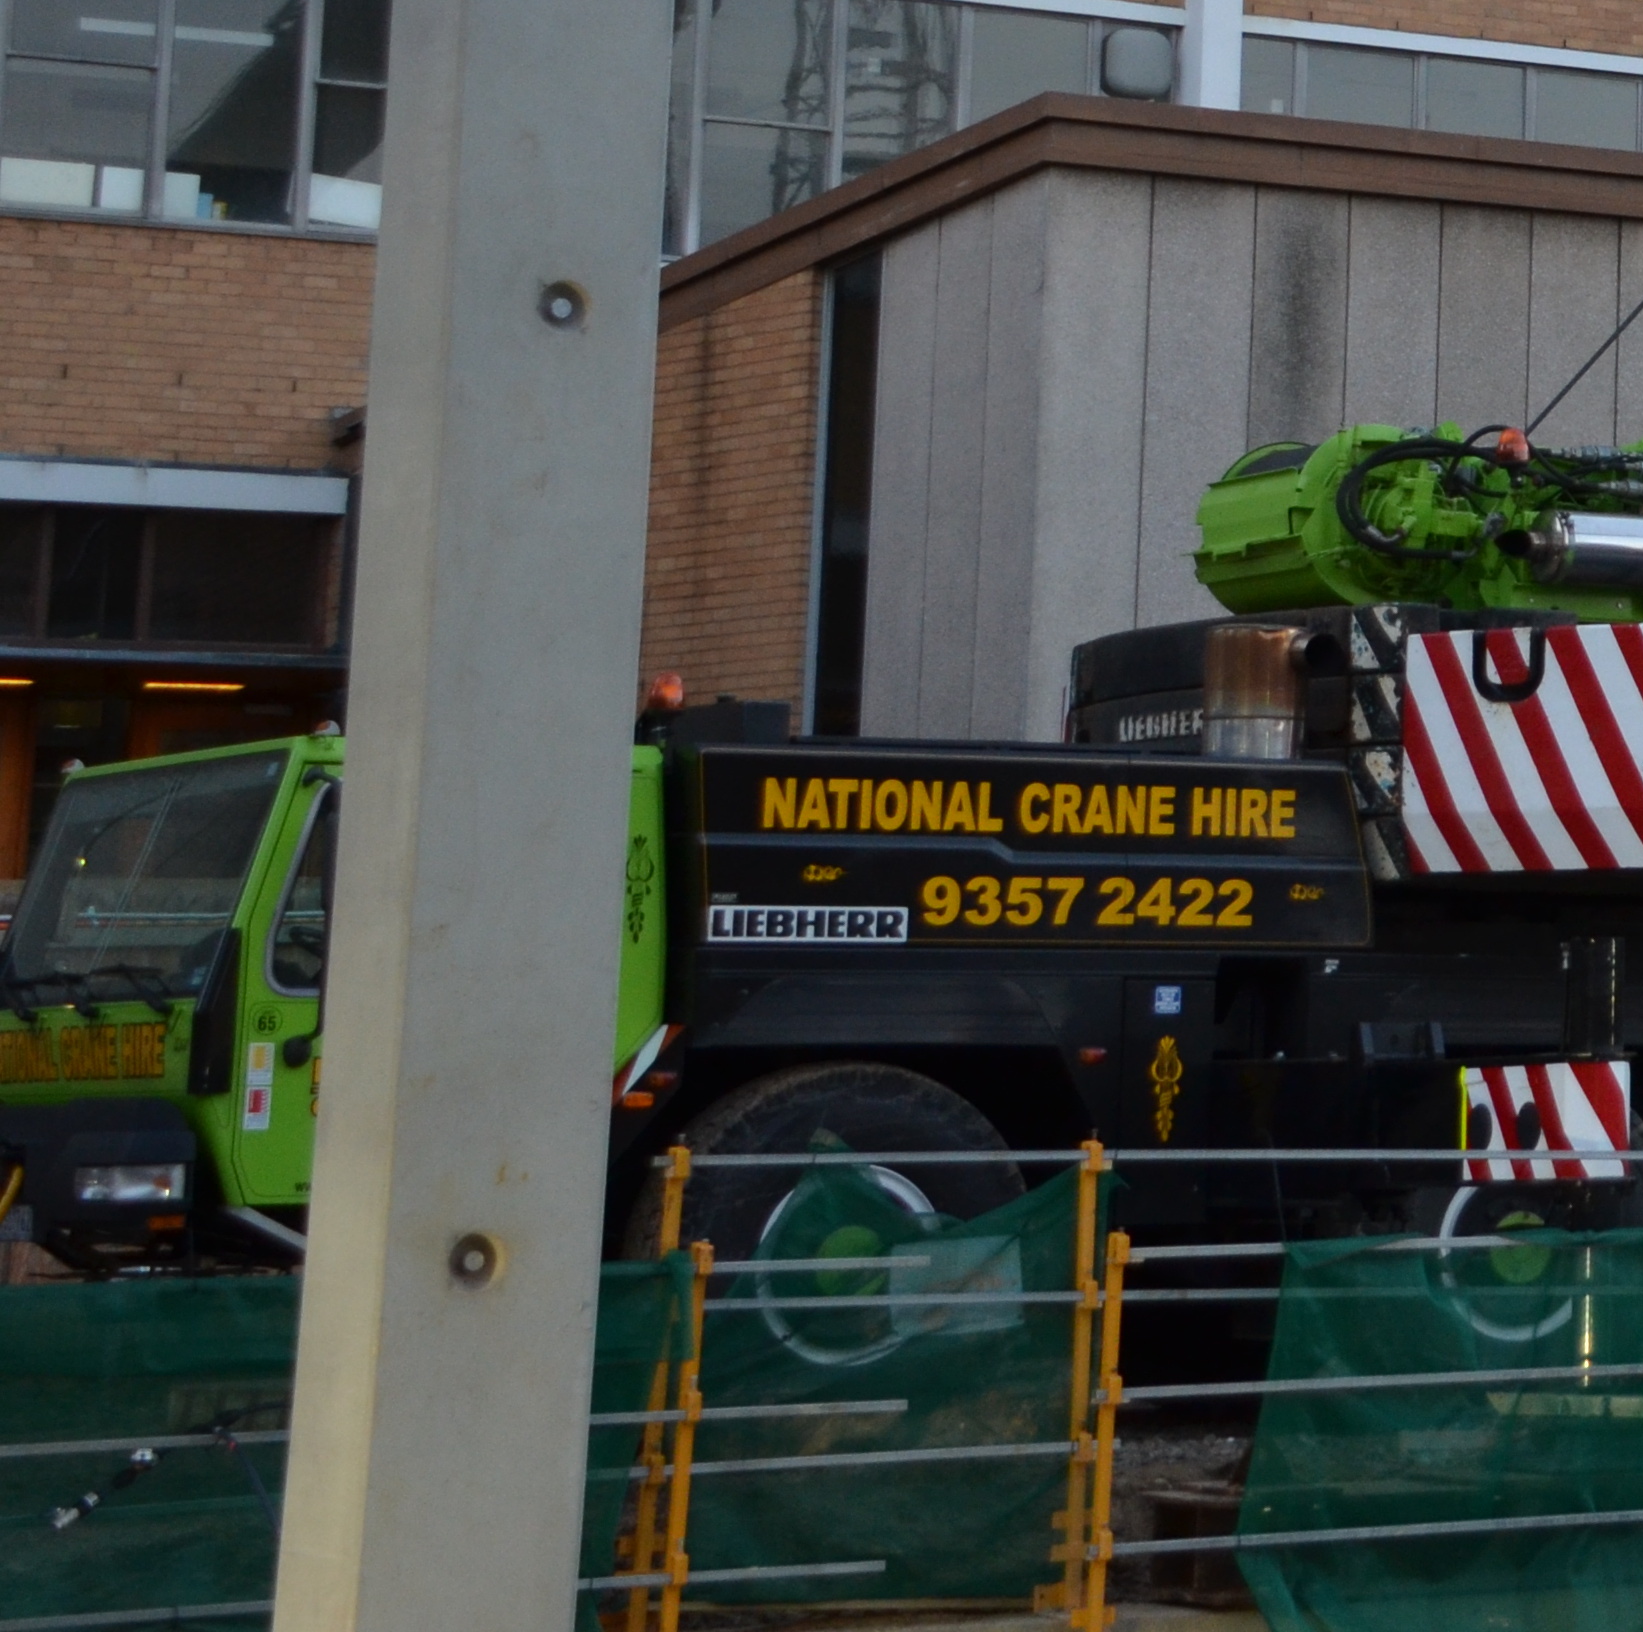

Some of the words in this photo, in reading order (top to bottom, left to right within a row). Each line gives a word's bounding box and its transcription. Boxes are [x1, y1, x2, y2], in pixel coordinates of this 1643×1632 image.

[1119, 708, 1204, 742] LIEBHER
[762, 777, 1004, 833] NATIONAL
[1019, 782, 1177, 836] CRANE
[1191, 786, 1297, 839] HIRE
[921, 875, 1086, 927] 9357
[1096, 876, 1254, 927] 2422
[711, 909, 905, 940] LIEBHERR
[257, 1014, 277, 1032] 65
[60, 1024, 120, 1081] CRANE
[122, 1021, 167, 1079] HIRE
